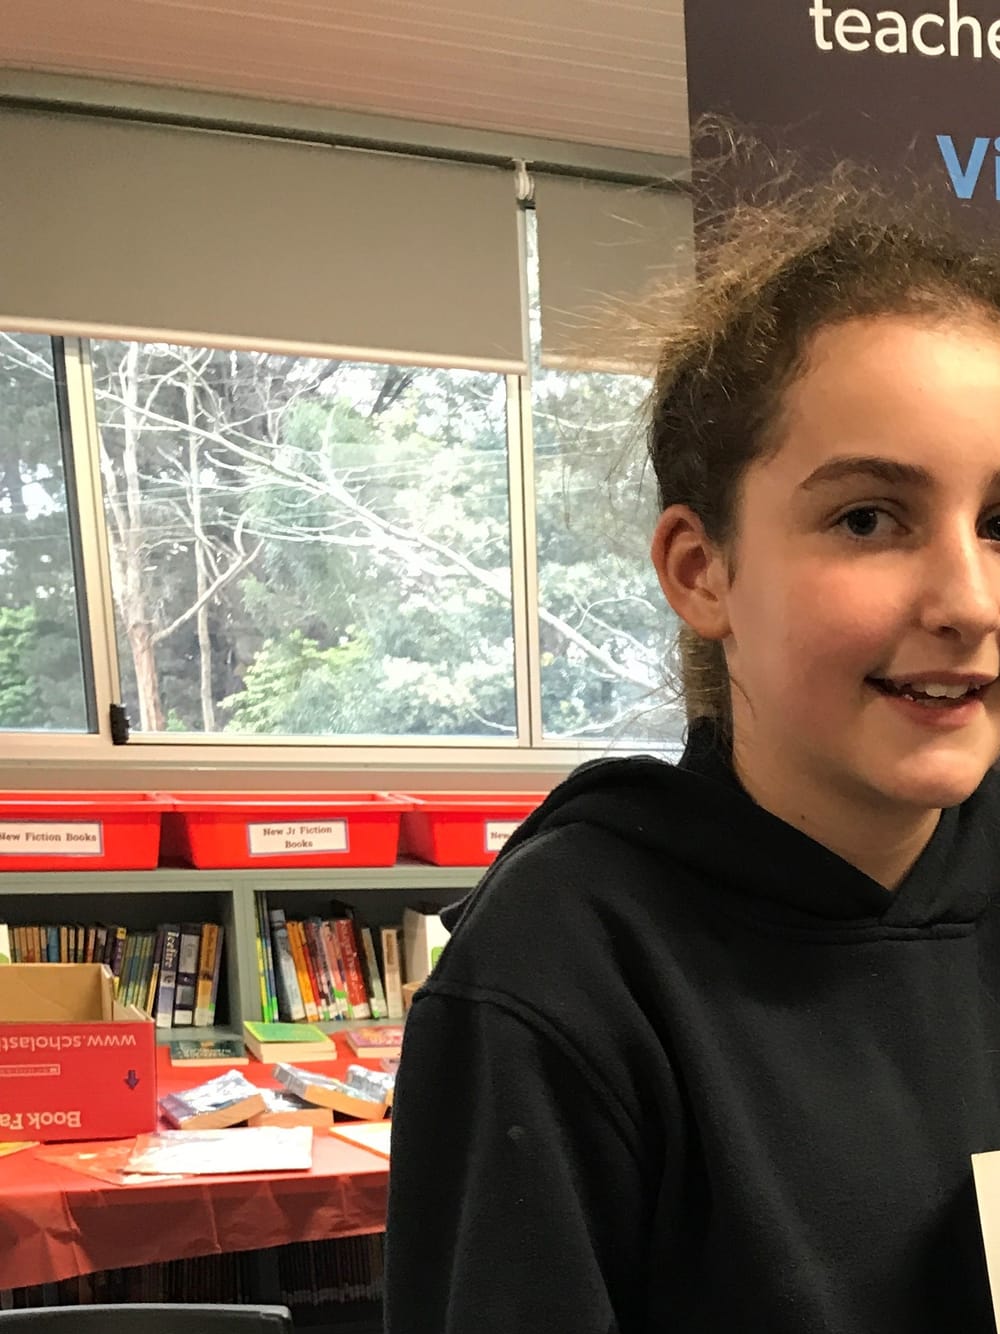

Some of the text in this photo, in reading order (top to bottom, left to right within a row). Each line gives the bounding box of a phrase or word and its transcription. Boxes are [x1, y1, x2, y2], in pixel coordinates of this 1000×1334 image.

[263, 828, 283, 836] New
[300, 826, 332, 834] Fiction
[25, 832, 61, 841] Fiction
[66, 832, 97, 842] Books
[285, 840, 313, 848] Books
[27, 1110, 81, 1130] Book
